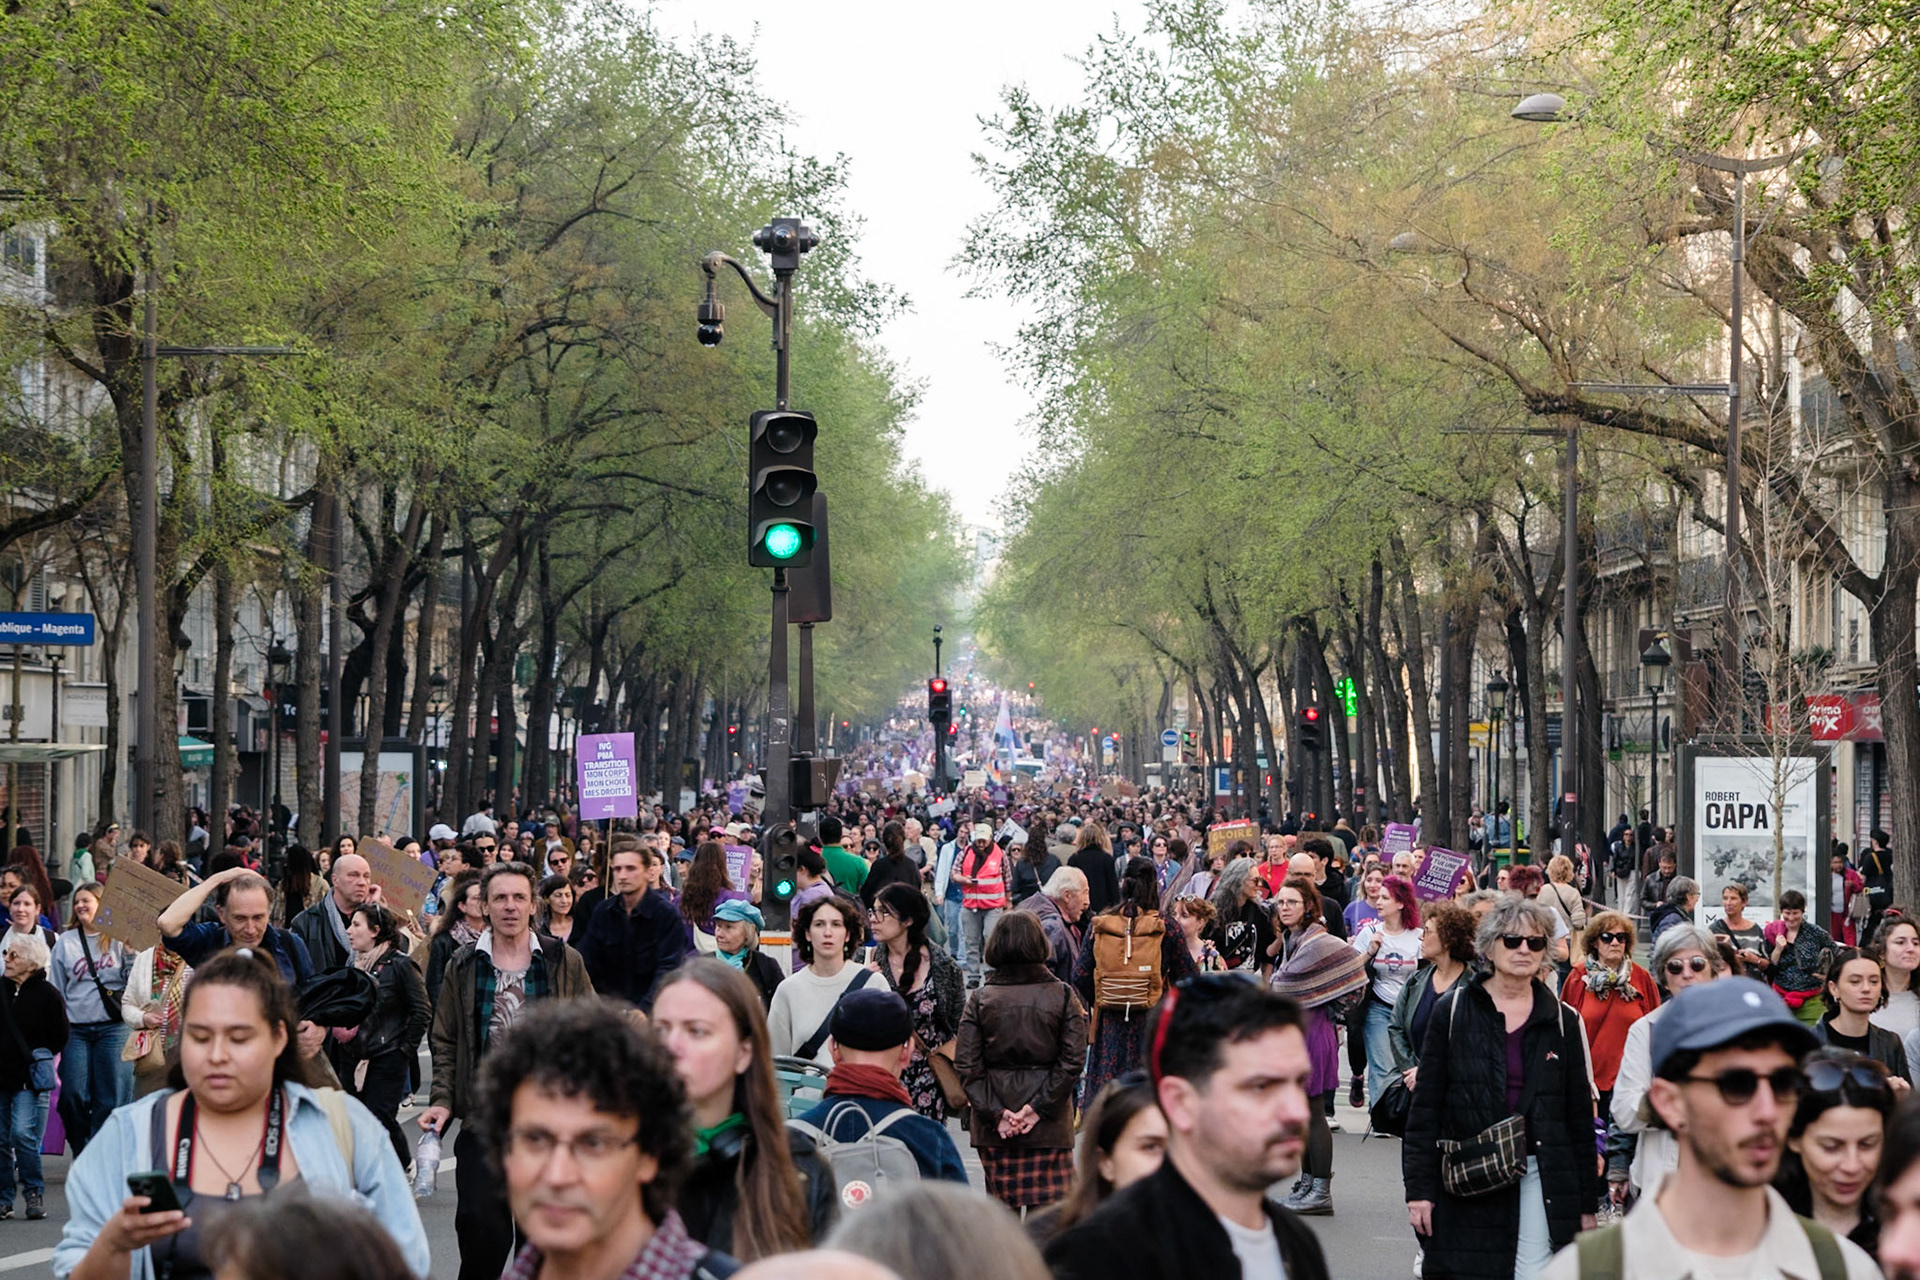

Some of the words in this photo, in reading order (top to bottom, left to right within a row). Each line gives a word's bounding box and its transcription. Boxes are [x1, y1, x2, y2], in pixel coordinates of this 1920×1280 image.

[42, 623, 85, 636] Magenta
[598, 742, 612, 750] IVG
[597, 751, 614, 760] PMA
[584, 759, 628, 770] TRANSITION
[586, 770, 603, 778] MON
[604, 768, 628, 777] CORPS
[587, 779, 604, 787] MON
[604, 778, 627, 787] CHOIX
[585, 788, 600, 797] MES
[600, 787, 627, 796] DROITS
[1705, 791, 1741, 801] ROBERT
[1705, 803, 1769, 829] CAPA
[1212, 828, 1253, 841] GLOIRE
[1434, 858, 1444, 866] TUE
[1445, 861, 1456, 869] UNE
[1441, 855, 1463, 864] HOMME
[1432, 865, 1452, 873] FEMME
[1427, 870, 1440, 878] TOUS
[1440, 873, 1451, 882] LES
[1425, 882, 1449, 894] FRANCE
[1430, 878, 1450, 888] JOURS
[73, 953, 115, 981] Grls
[265, 1127, 279, 1156] EOS
